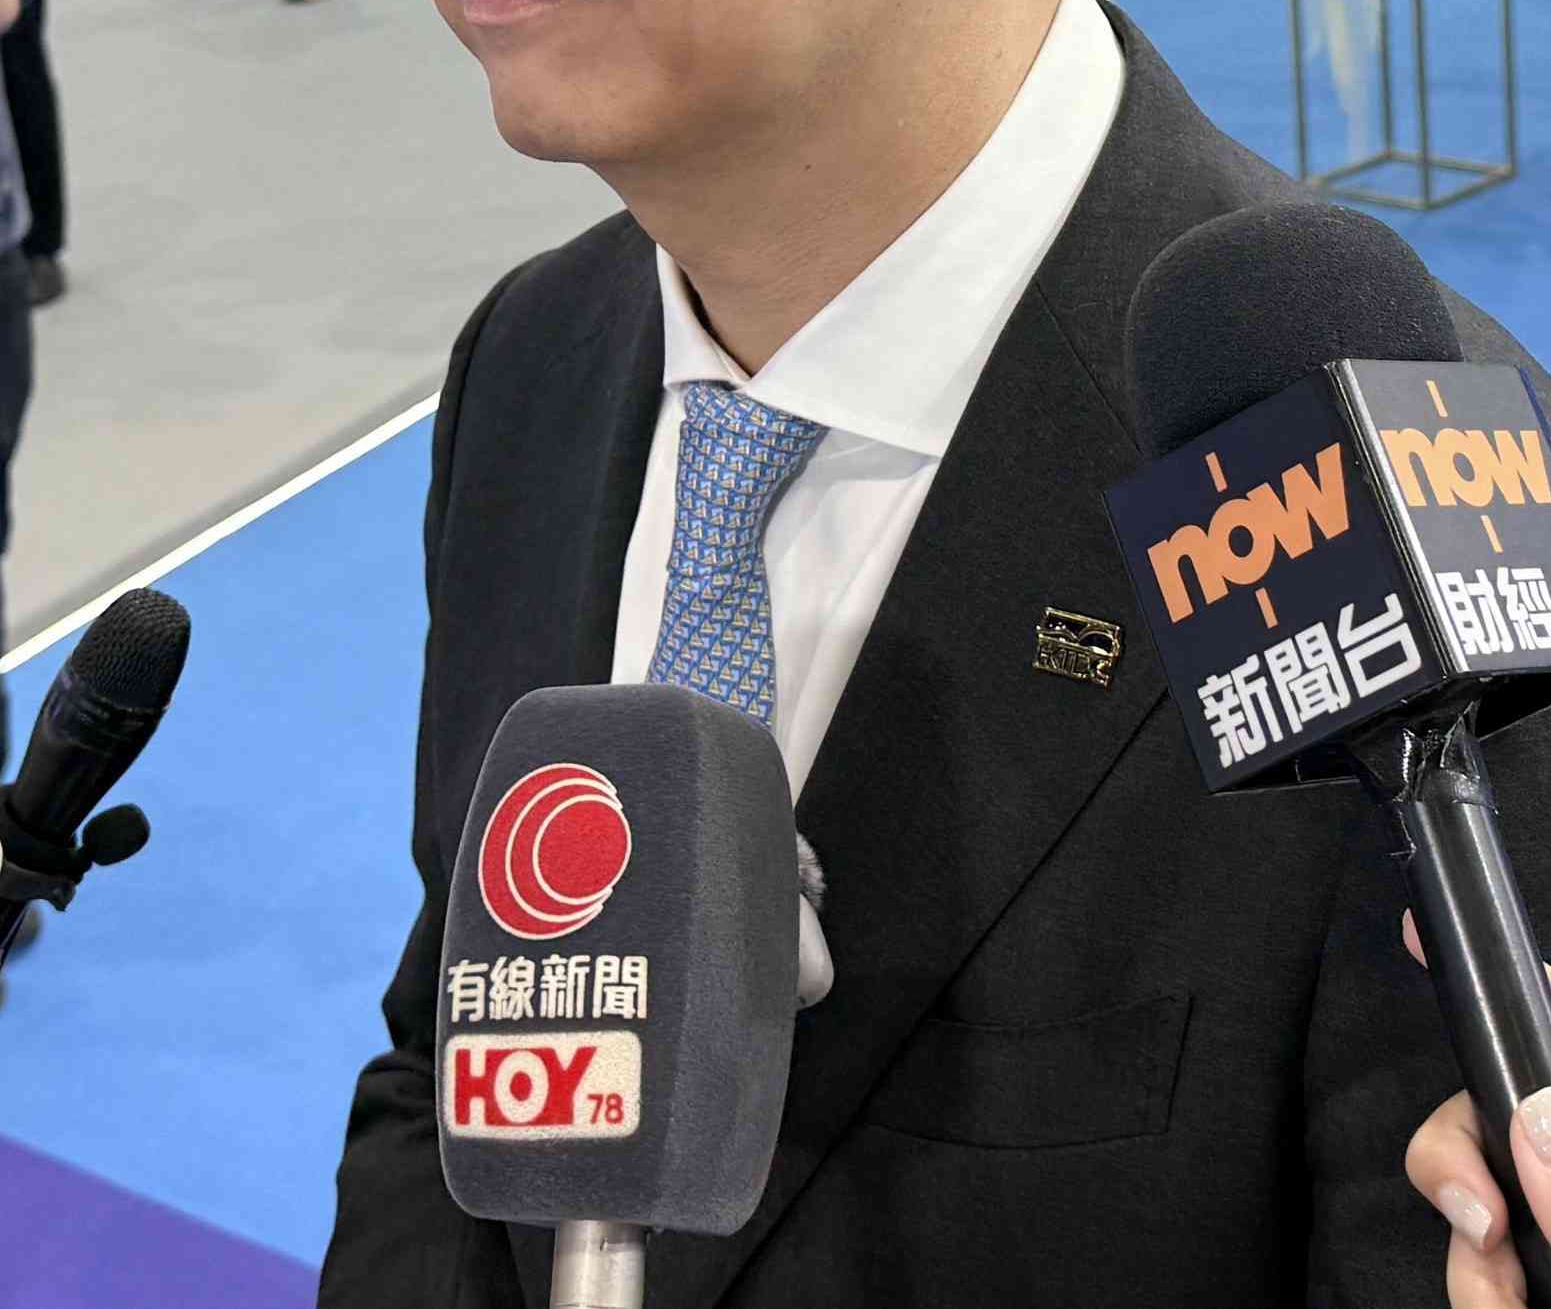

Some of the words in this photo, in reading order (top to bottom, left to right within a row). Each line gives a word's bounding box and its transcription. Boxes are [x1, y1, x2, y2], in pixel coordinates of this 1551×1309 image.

[1148, 441, 1351, 623] now
[1197, 592, 1423, 769] 新聞台
[447, 953, 648, 1024] 有線新聞
[453, 1046, 597, 1127] HOY
[587, 1093, 624, 1125] 78
